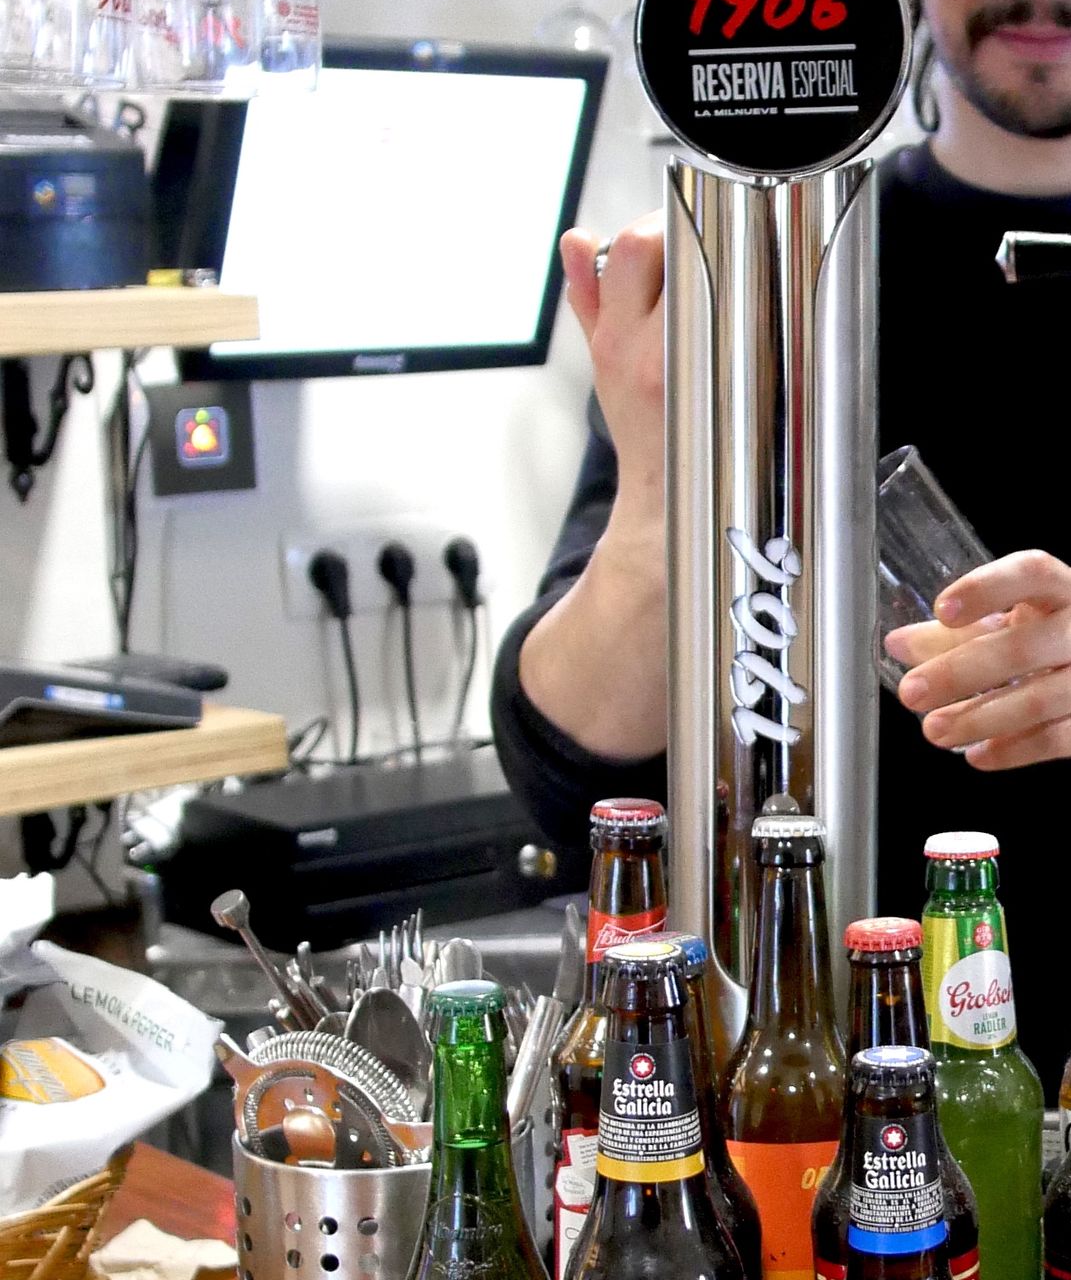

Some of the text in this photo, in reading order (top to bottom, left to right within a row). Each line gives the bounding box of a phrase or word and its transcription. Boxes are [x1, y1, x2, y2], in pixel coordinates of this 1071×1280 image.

[692, 59, 858, 102] RESERVA ESPECIAL
[726, 526, 807, 746] 1906
[70, 983, 123, 1021] LEMON
[129, 1008, 177, 1053] PEPPER
[973, 1017, 1007, 1036] RADLER
[612, 1078, 674, 1098] Estrella
[614, 1097, 672, 1116] Galicia
[863, 1151, 926, 1170] Estrella
[865, 1170, 925, 1189] Galicia
